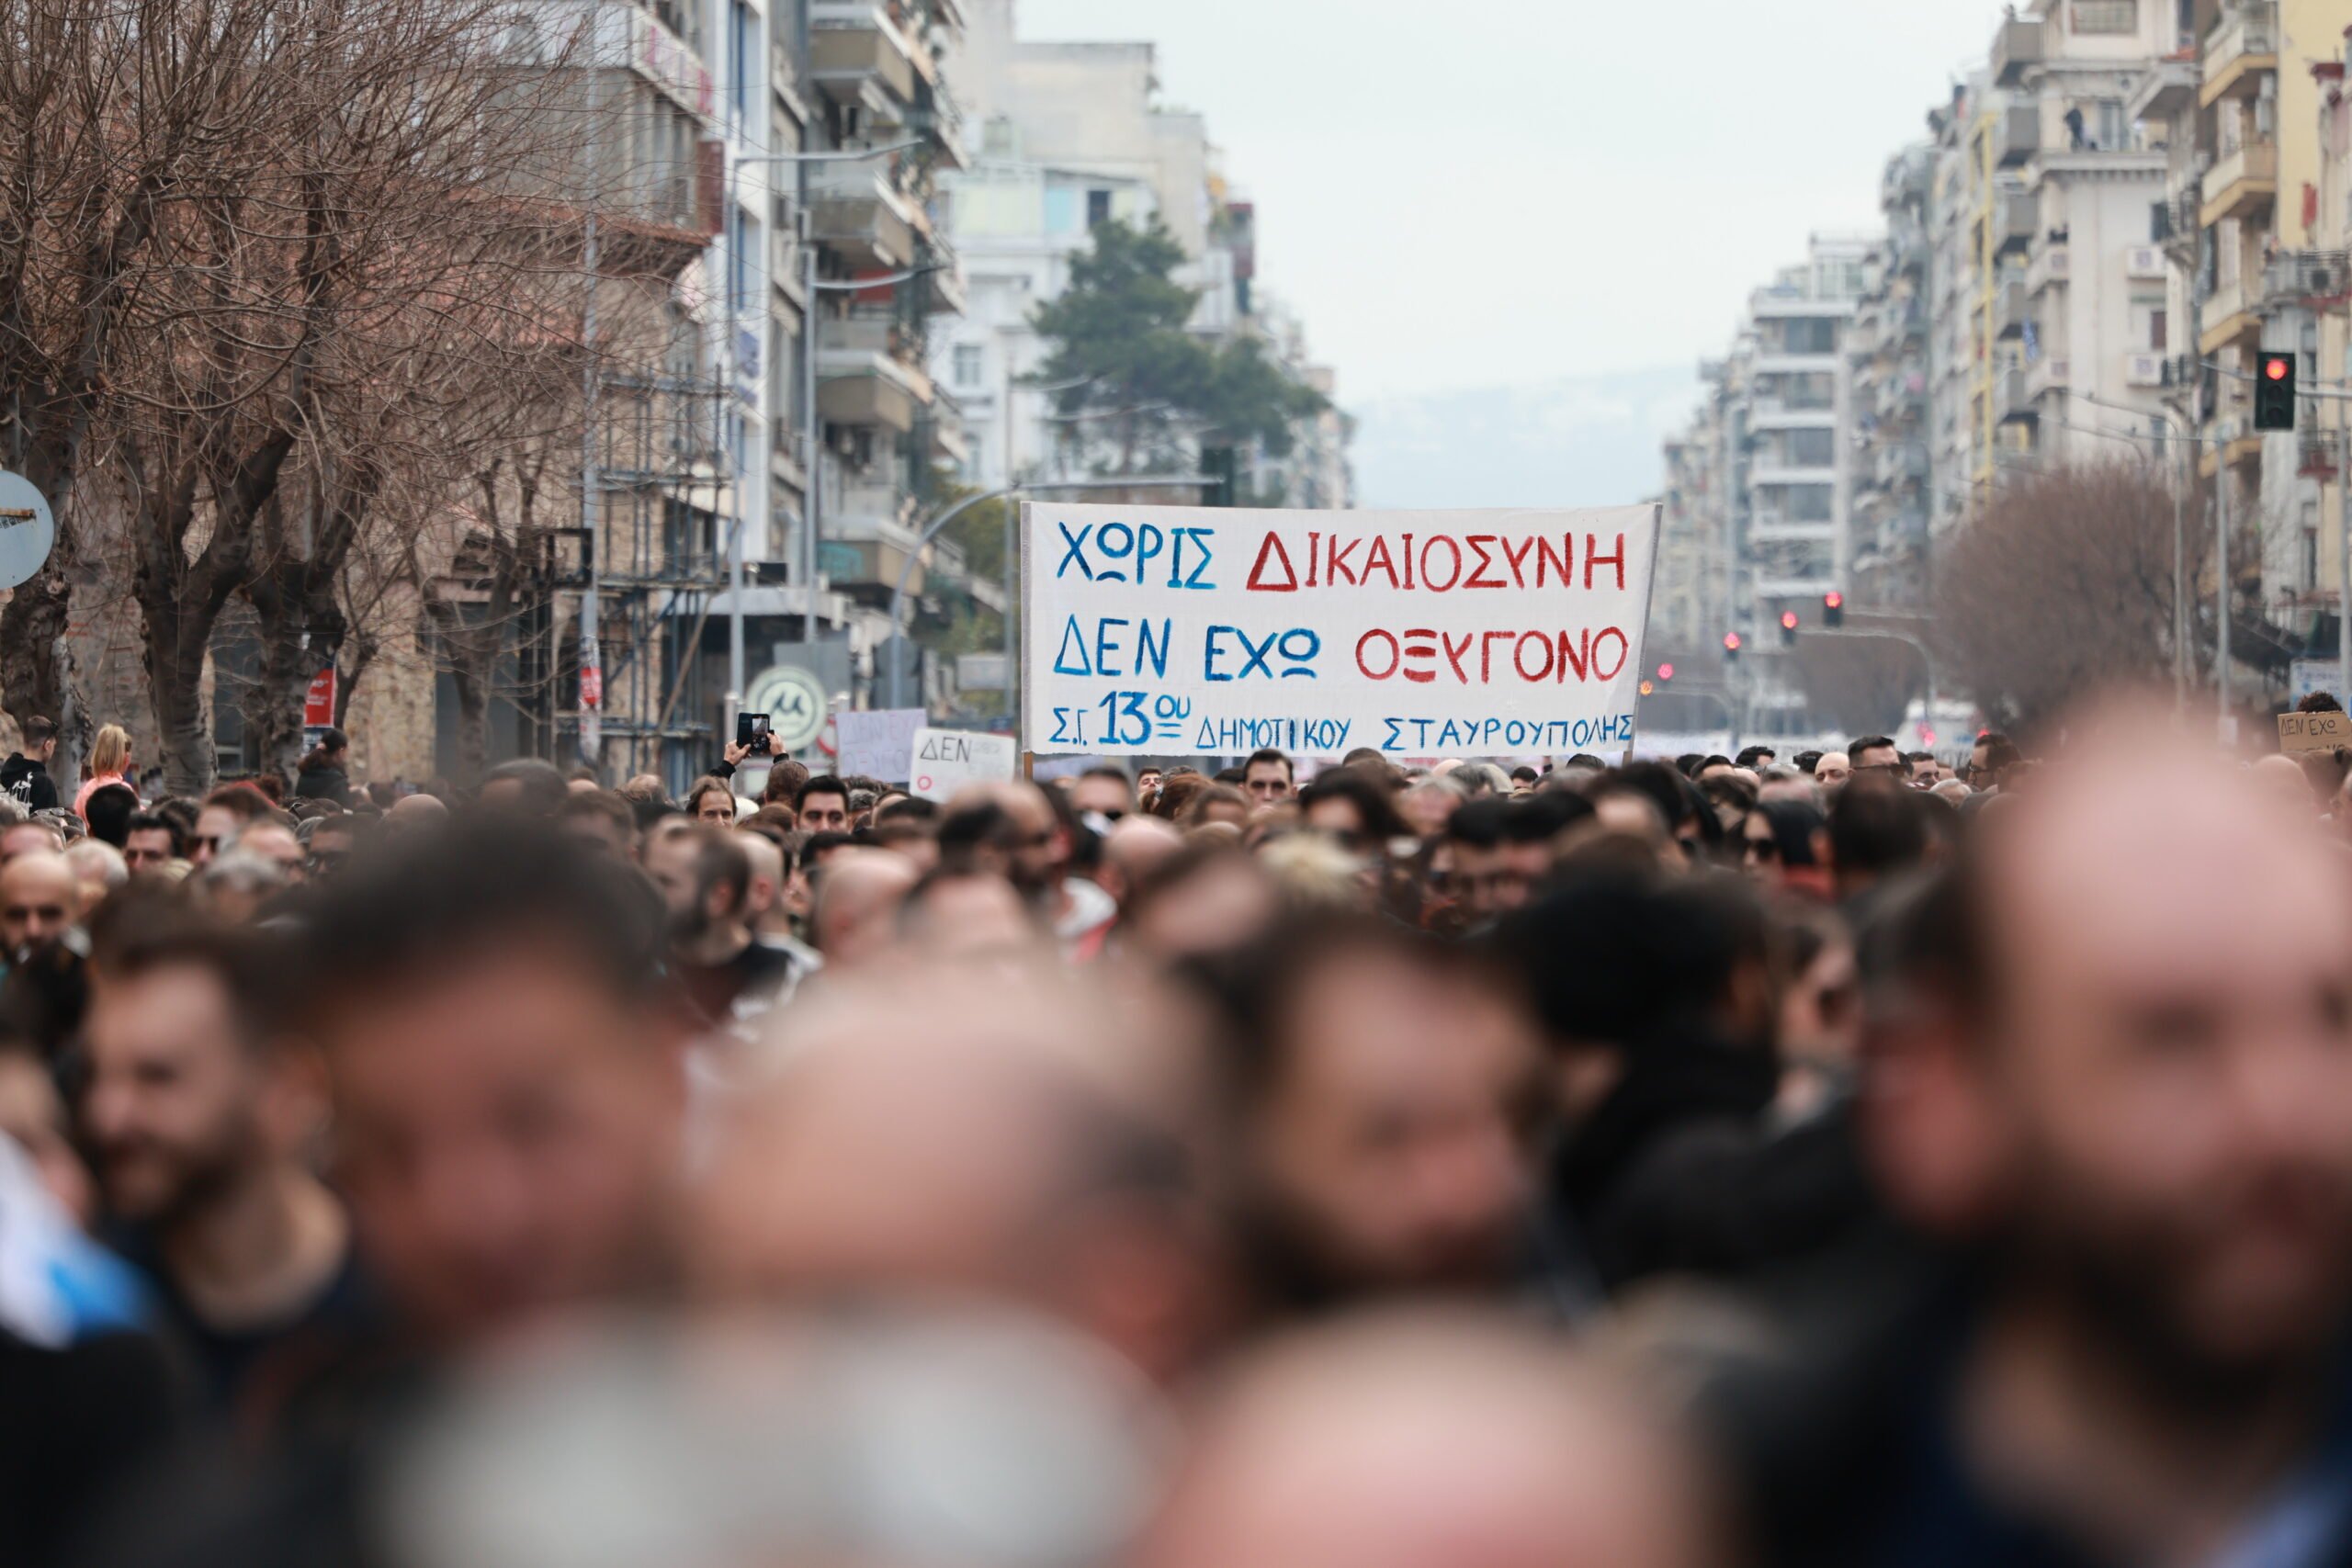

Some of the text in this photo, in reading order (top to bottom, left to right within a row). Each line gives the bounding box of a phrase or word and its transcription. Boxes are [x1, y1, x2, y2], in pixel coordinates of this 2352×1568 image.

[1057, 522, 1625, 592] ΧΩΡΙΣ ΔΙΚΑΙΟΣΥΝΗ
[1053, 614, 1628, 684] ΔΕΝ ΕΧΩ ΟΞΥΓΟΝΟ
[1195, 716, 1351, 750] ΔΗΜΟΤΙΚΟΥ
[1381, 714, 1633, 751] ΣΤΑΥΡΟΥΠΟΛΗΣ
[2280, 718, 2338, 737] ΔΕΝ ΕΧΩ
[919, 736, 972, 763] ΔΕΝ
